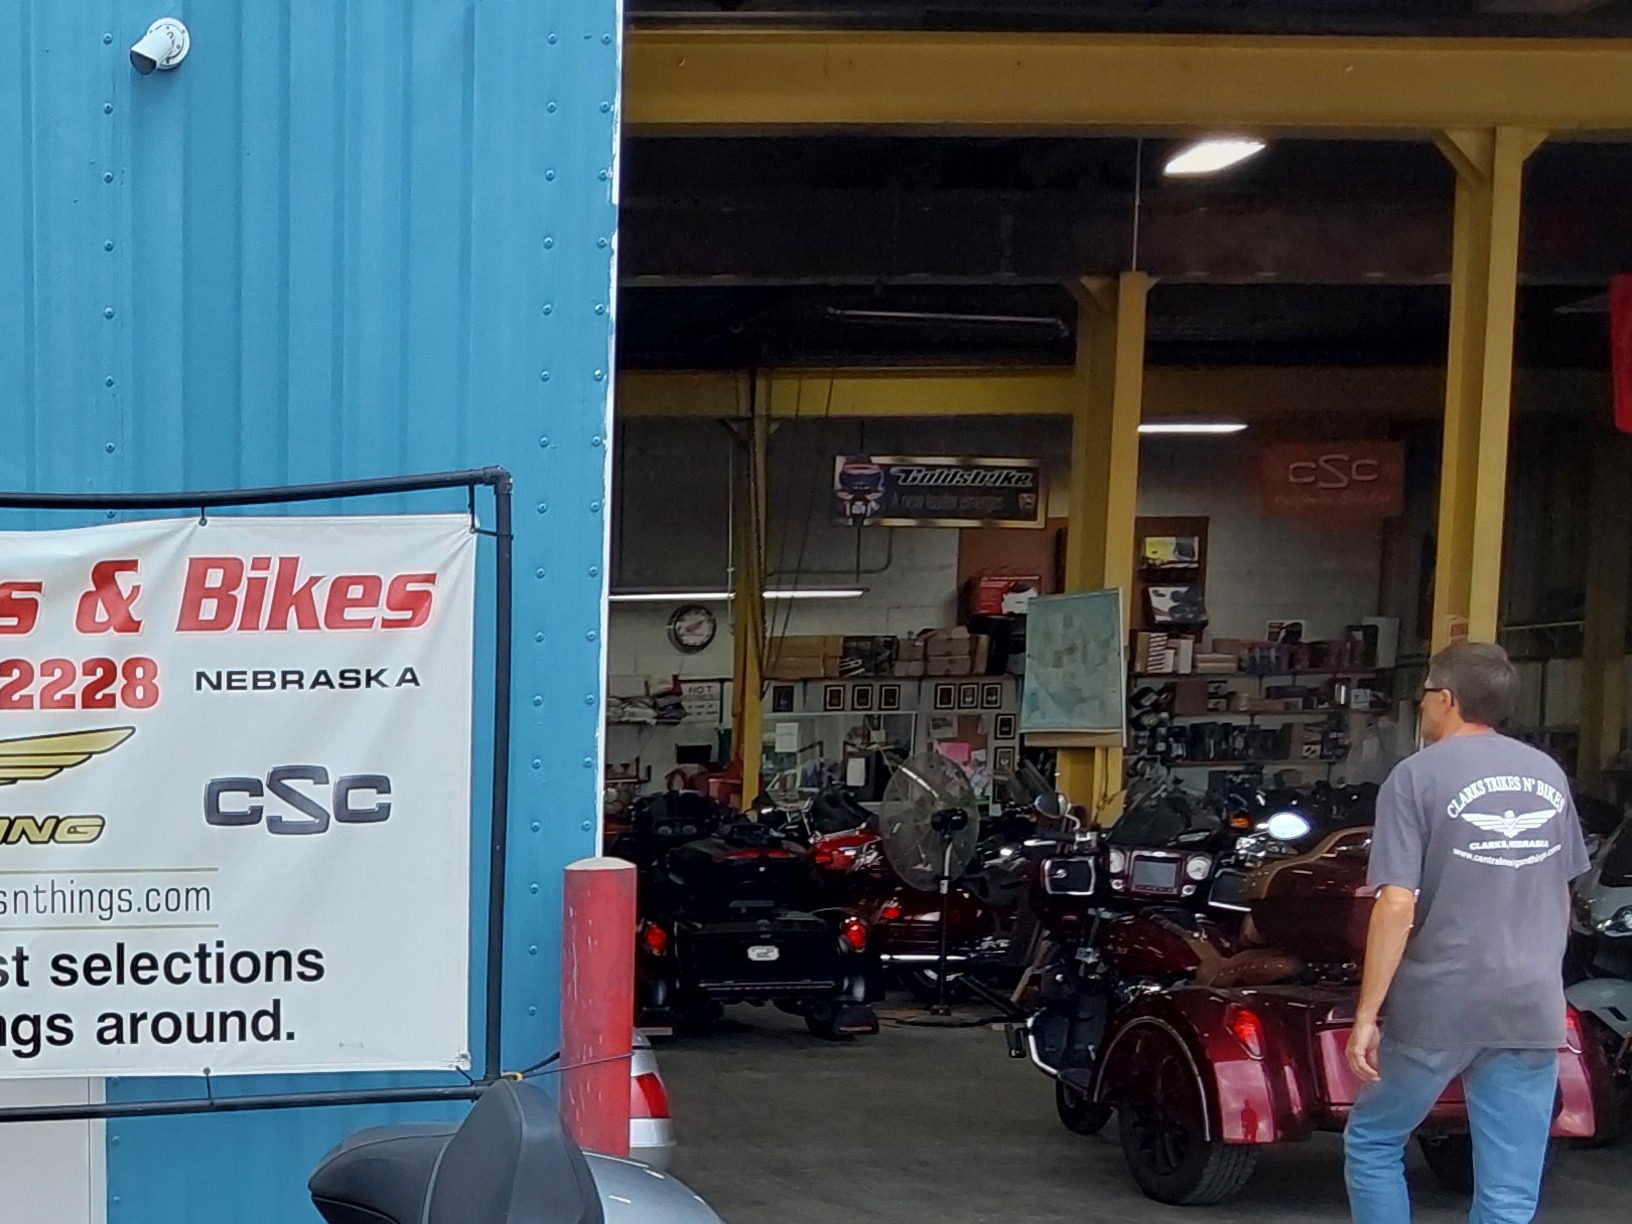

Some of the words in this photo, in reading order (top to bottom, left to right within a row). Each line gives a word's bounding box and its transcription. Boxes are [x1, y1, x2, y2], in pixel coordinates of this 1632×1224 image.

[75, 560, 143, 635] &
[176, 556, 438, 632] Bikes
[196, 667, 421, 691] NEBRASKA
[1447, 780, 1486, 818] CLARKS
[1484, 776, 1522, 793] TRIKES
[1536, 780, 1566, 813] BIKES
[50, 940, 325, 988] selections
[96, 998, 296, 1046] around.
